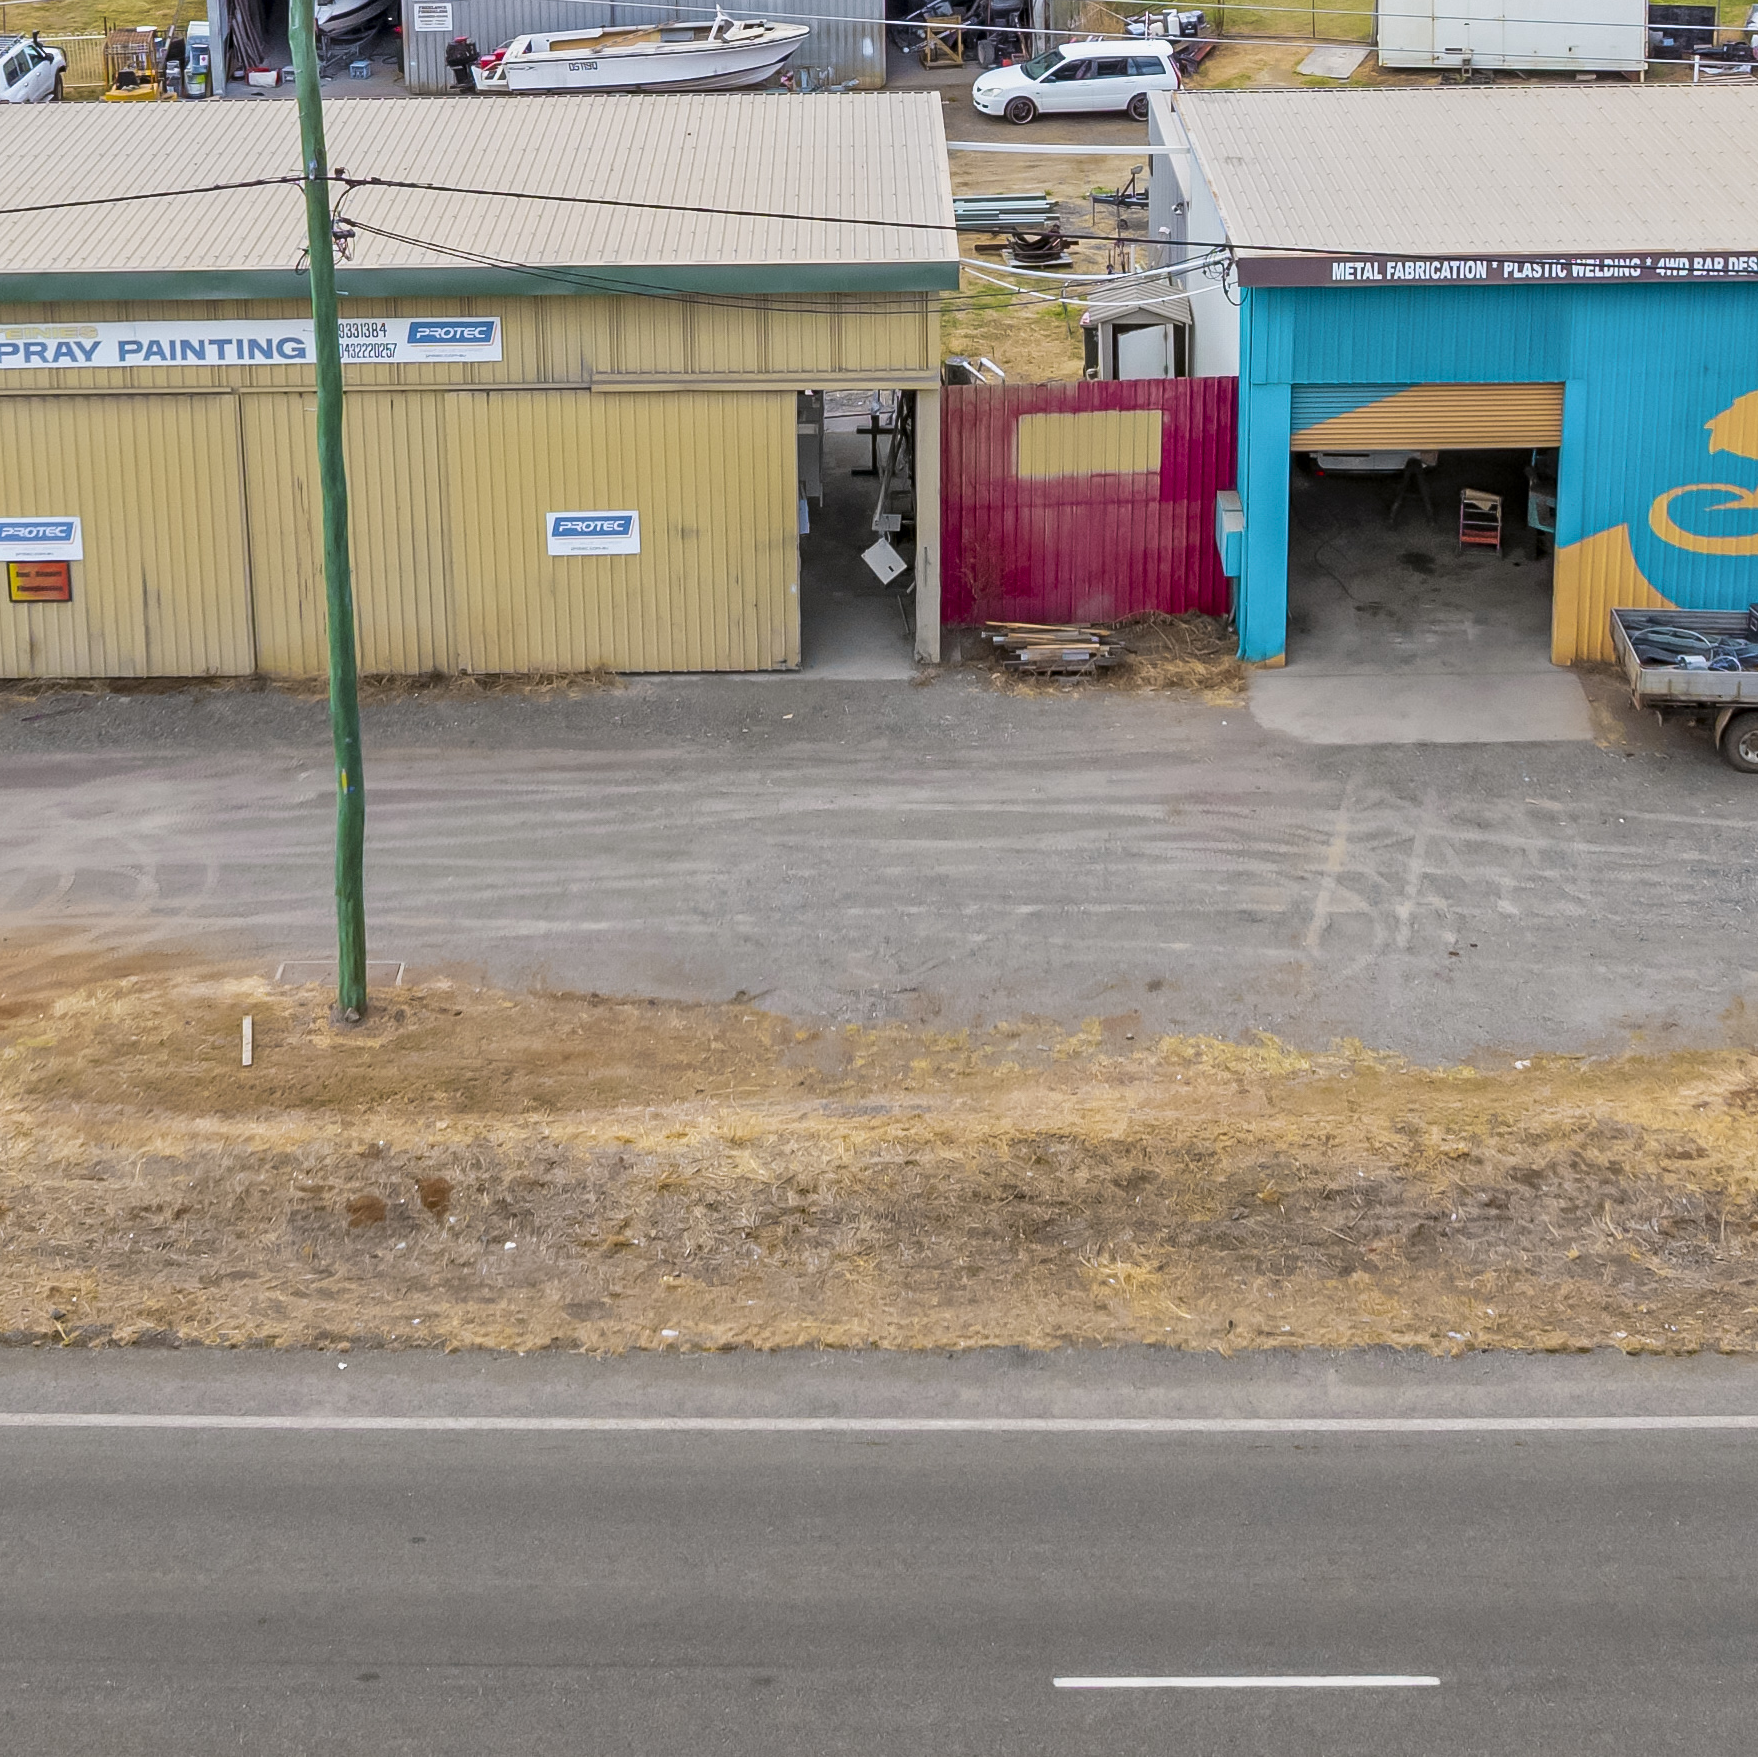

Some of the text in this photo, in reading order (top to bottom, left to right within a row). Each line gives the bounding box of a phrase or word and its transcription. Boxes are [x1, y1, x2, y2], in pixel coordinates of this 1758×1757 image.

[1332, 260, 1487, 280] METAL FABRICATION
[1503, 258, 1641, 278] PLASTIC WELDING
[1656, 257, 1690, 276] 4WD
[1693, 257, 1725, 276] BAR
[416, 327, 487, 339] PROTEC
[118, 337, 307, 362] PAINTING
[1, 526, 68, 538] PROTEC
[558, 520, 625, 532] PROTEC
